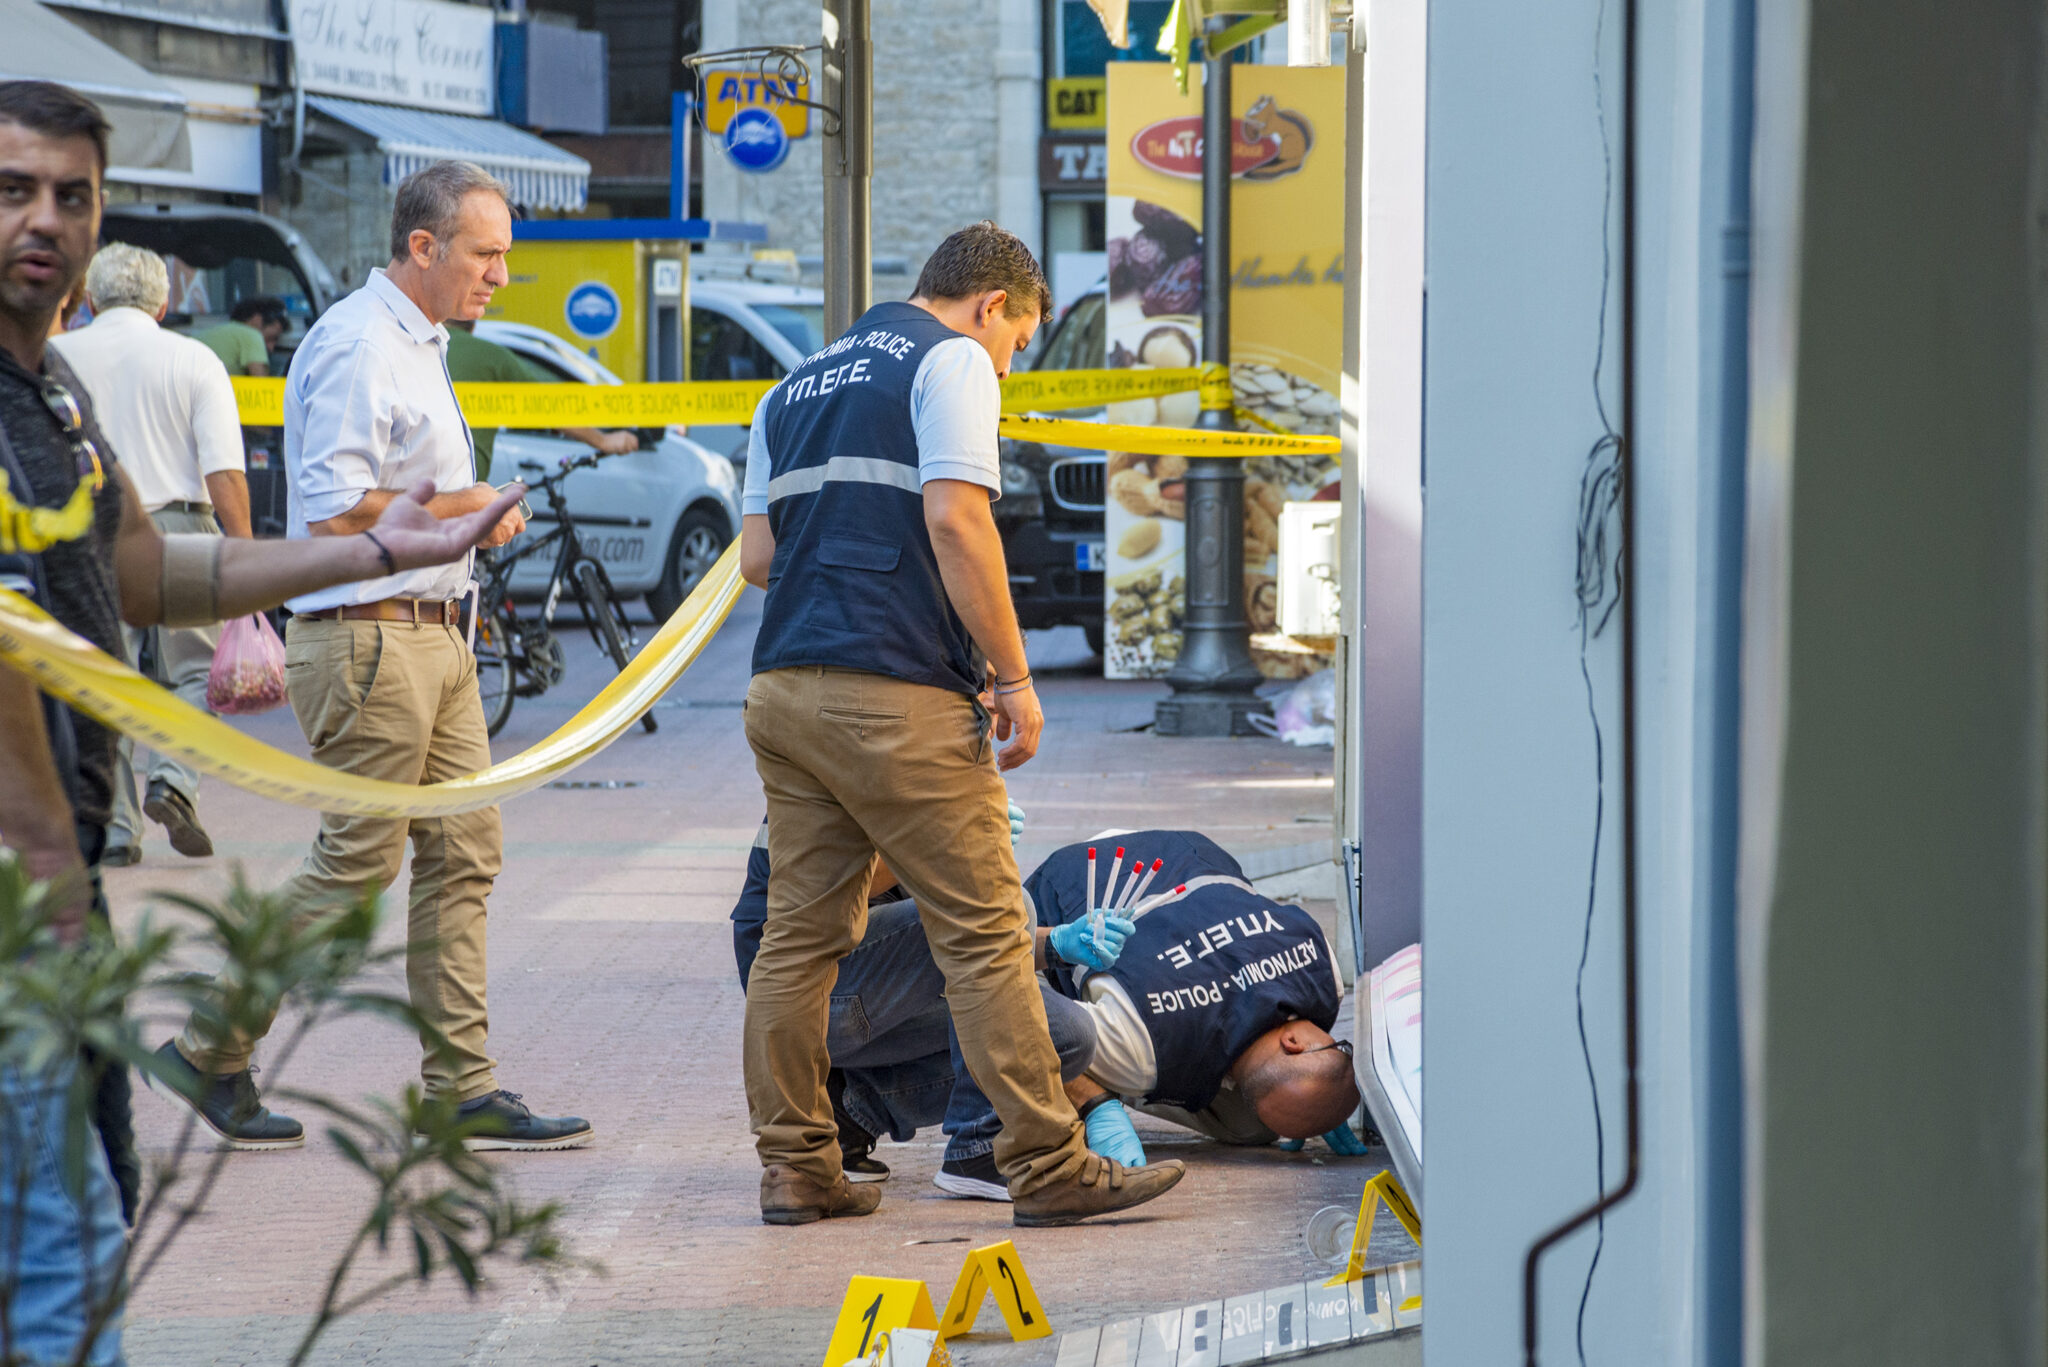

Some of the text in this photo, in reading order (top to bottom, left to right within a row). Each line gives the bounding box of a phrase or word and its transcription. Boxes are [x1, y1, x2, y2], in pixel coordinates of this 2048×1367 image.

[301, 1, 346, 47] The
[414, 9, 484, 69] Corner
[717, 77, 798, 106] ATM
[1057, 89, 1100, 116] CAT
[860, 331, 916, 361] POLICE
[1147, 981, 1224, 1014] POLICE
[997, 1256, 1034, 1327] 2
[857, 1293, 884, 1358] 1
